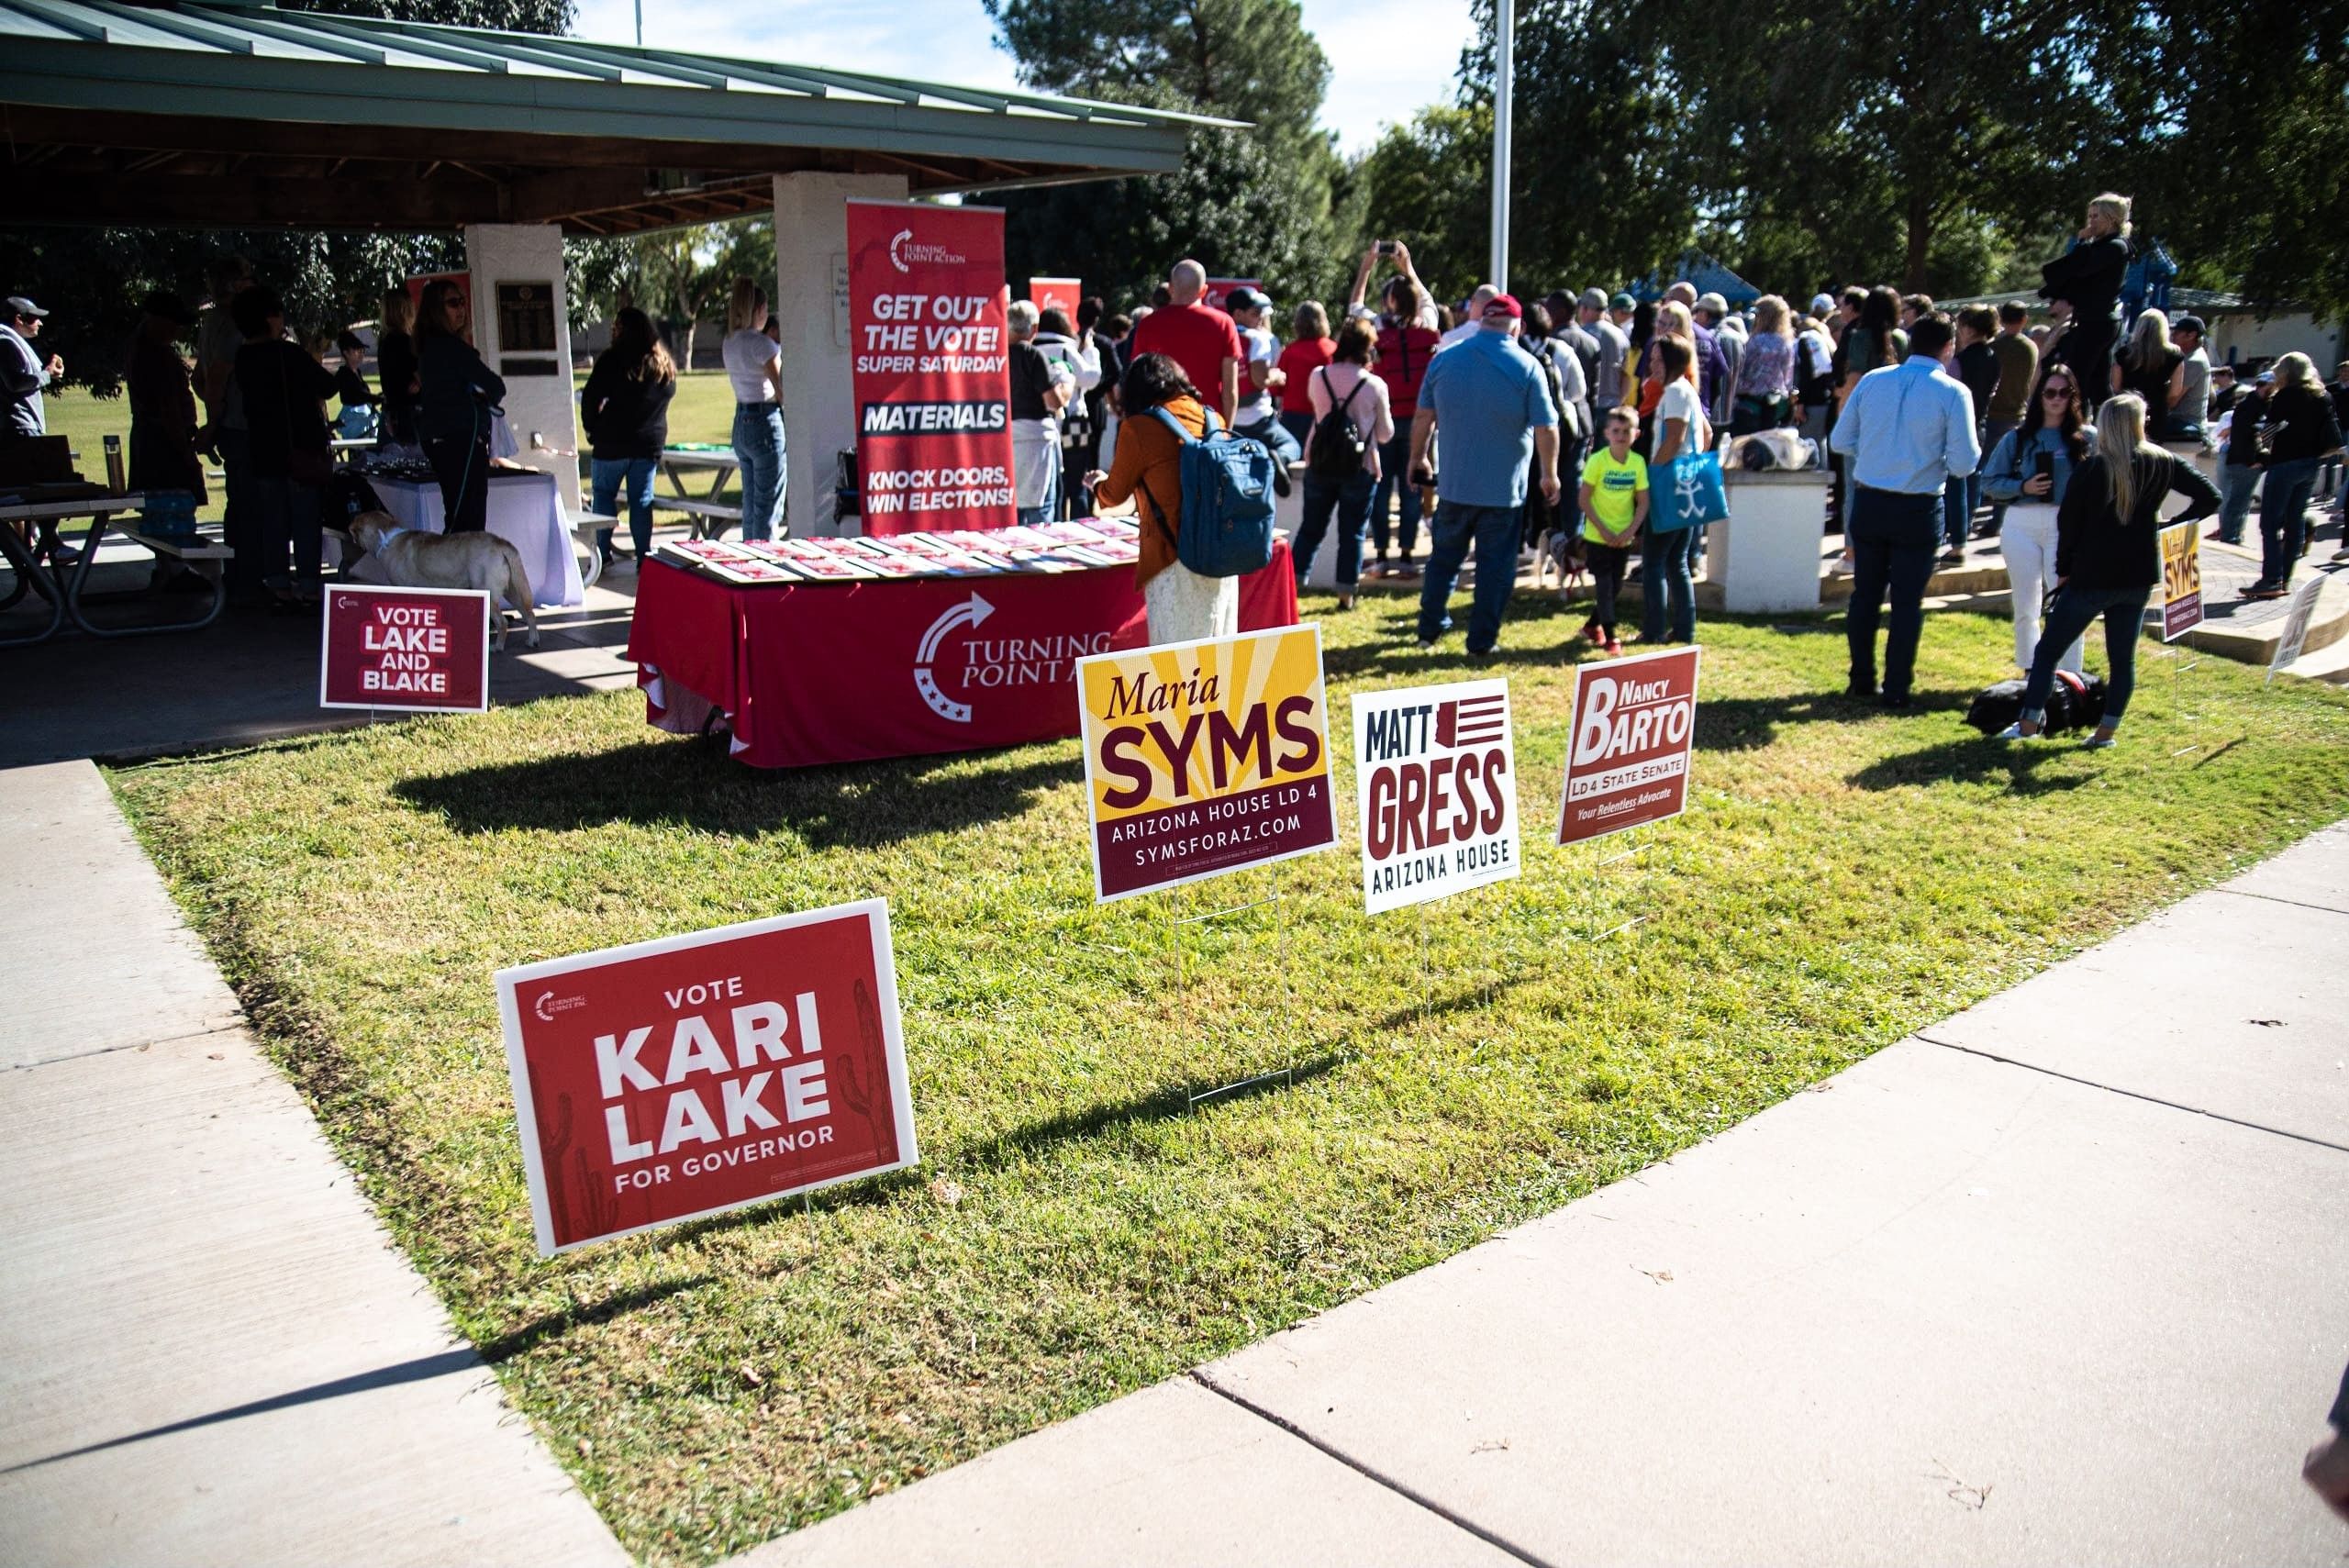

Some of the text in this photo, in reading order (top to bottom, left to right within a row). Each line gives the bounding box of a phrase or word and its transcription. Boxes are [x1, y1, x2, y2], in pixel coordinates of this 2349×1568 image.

[904, 244, 946, 255] TURNING
[904, 253, 965, 264] POINT ACTION
[874, 294, 988, 321] GET OUT
[864, 325, 999, 352] THE VOTE!
[857, 355, 1007, 374] SUPER SATURDAY
[864, 404, 1006, 432] MATERIALS
[868, 466, 1009, 492] KNOCK DOORS,
[866, 488, 1015, 514] WIN ELECTIONS!
[2165, 552, 2199, 599] SYMS
[377, 606, 437, 627] VOTE
[364, 626, 447, 653] LAKE
[963, 631, 1111, 665] TURNING
[381, 652, 430, 671] AND
[962, 660, 1063, 688] POINT
[363, 671, 446, 693] BLAKE
[1104, 667, 1220, 720] Maria
[1619, 679, 1670, 706] NANCY
[1365, 705, 1433, 762] MATT
[1572, 677, 1691, 767] BARTO
[1101, 695, 1320, 809] SYMS
[1602, 771, 1638, 789] STATE
[1642, 760, 1682, 779] SENATE
[1112, 784, 1318, 843] ARIZONA HOUSE LD 4
[1367, 749, 1507, 861] GRESS
[1578, 788, 1672, 821] Your Relentless Advocate
[1135, 814, 1301, 866] SYMSFORAZ.COM
[1373, 839, 1509, 895] ARIZONA HOUSE
[664, 975, 744, 1009] VOTE
[594, 991, 822, 1099] KARI
[605, 1059, 831, 1165] LAKE
[615, 1164, 672, 1194] FOR
[682, 1125, 835, 1176] GOVERNOR
